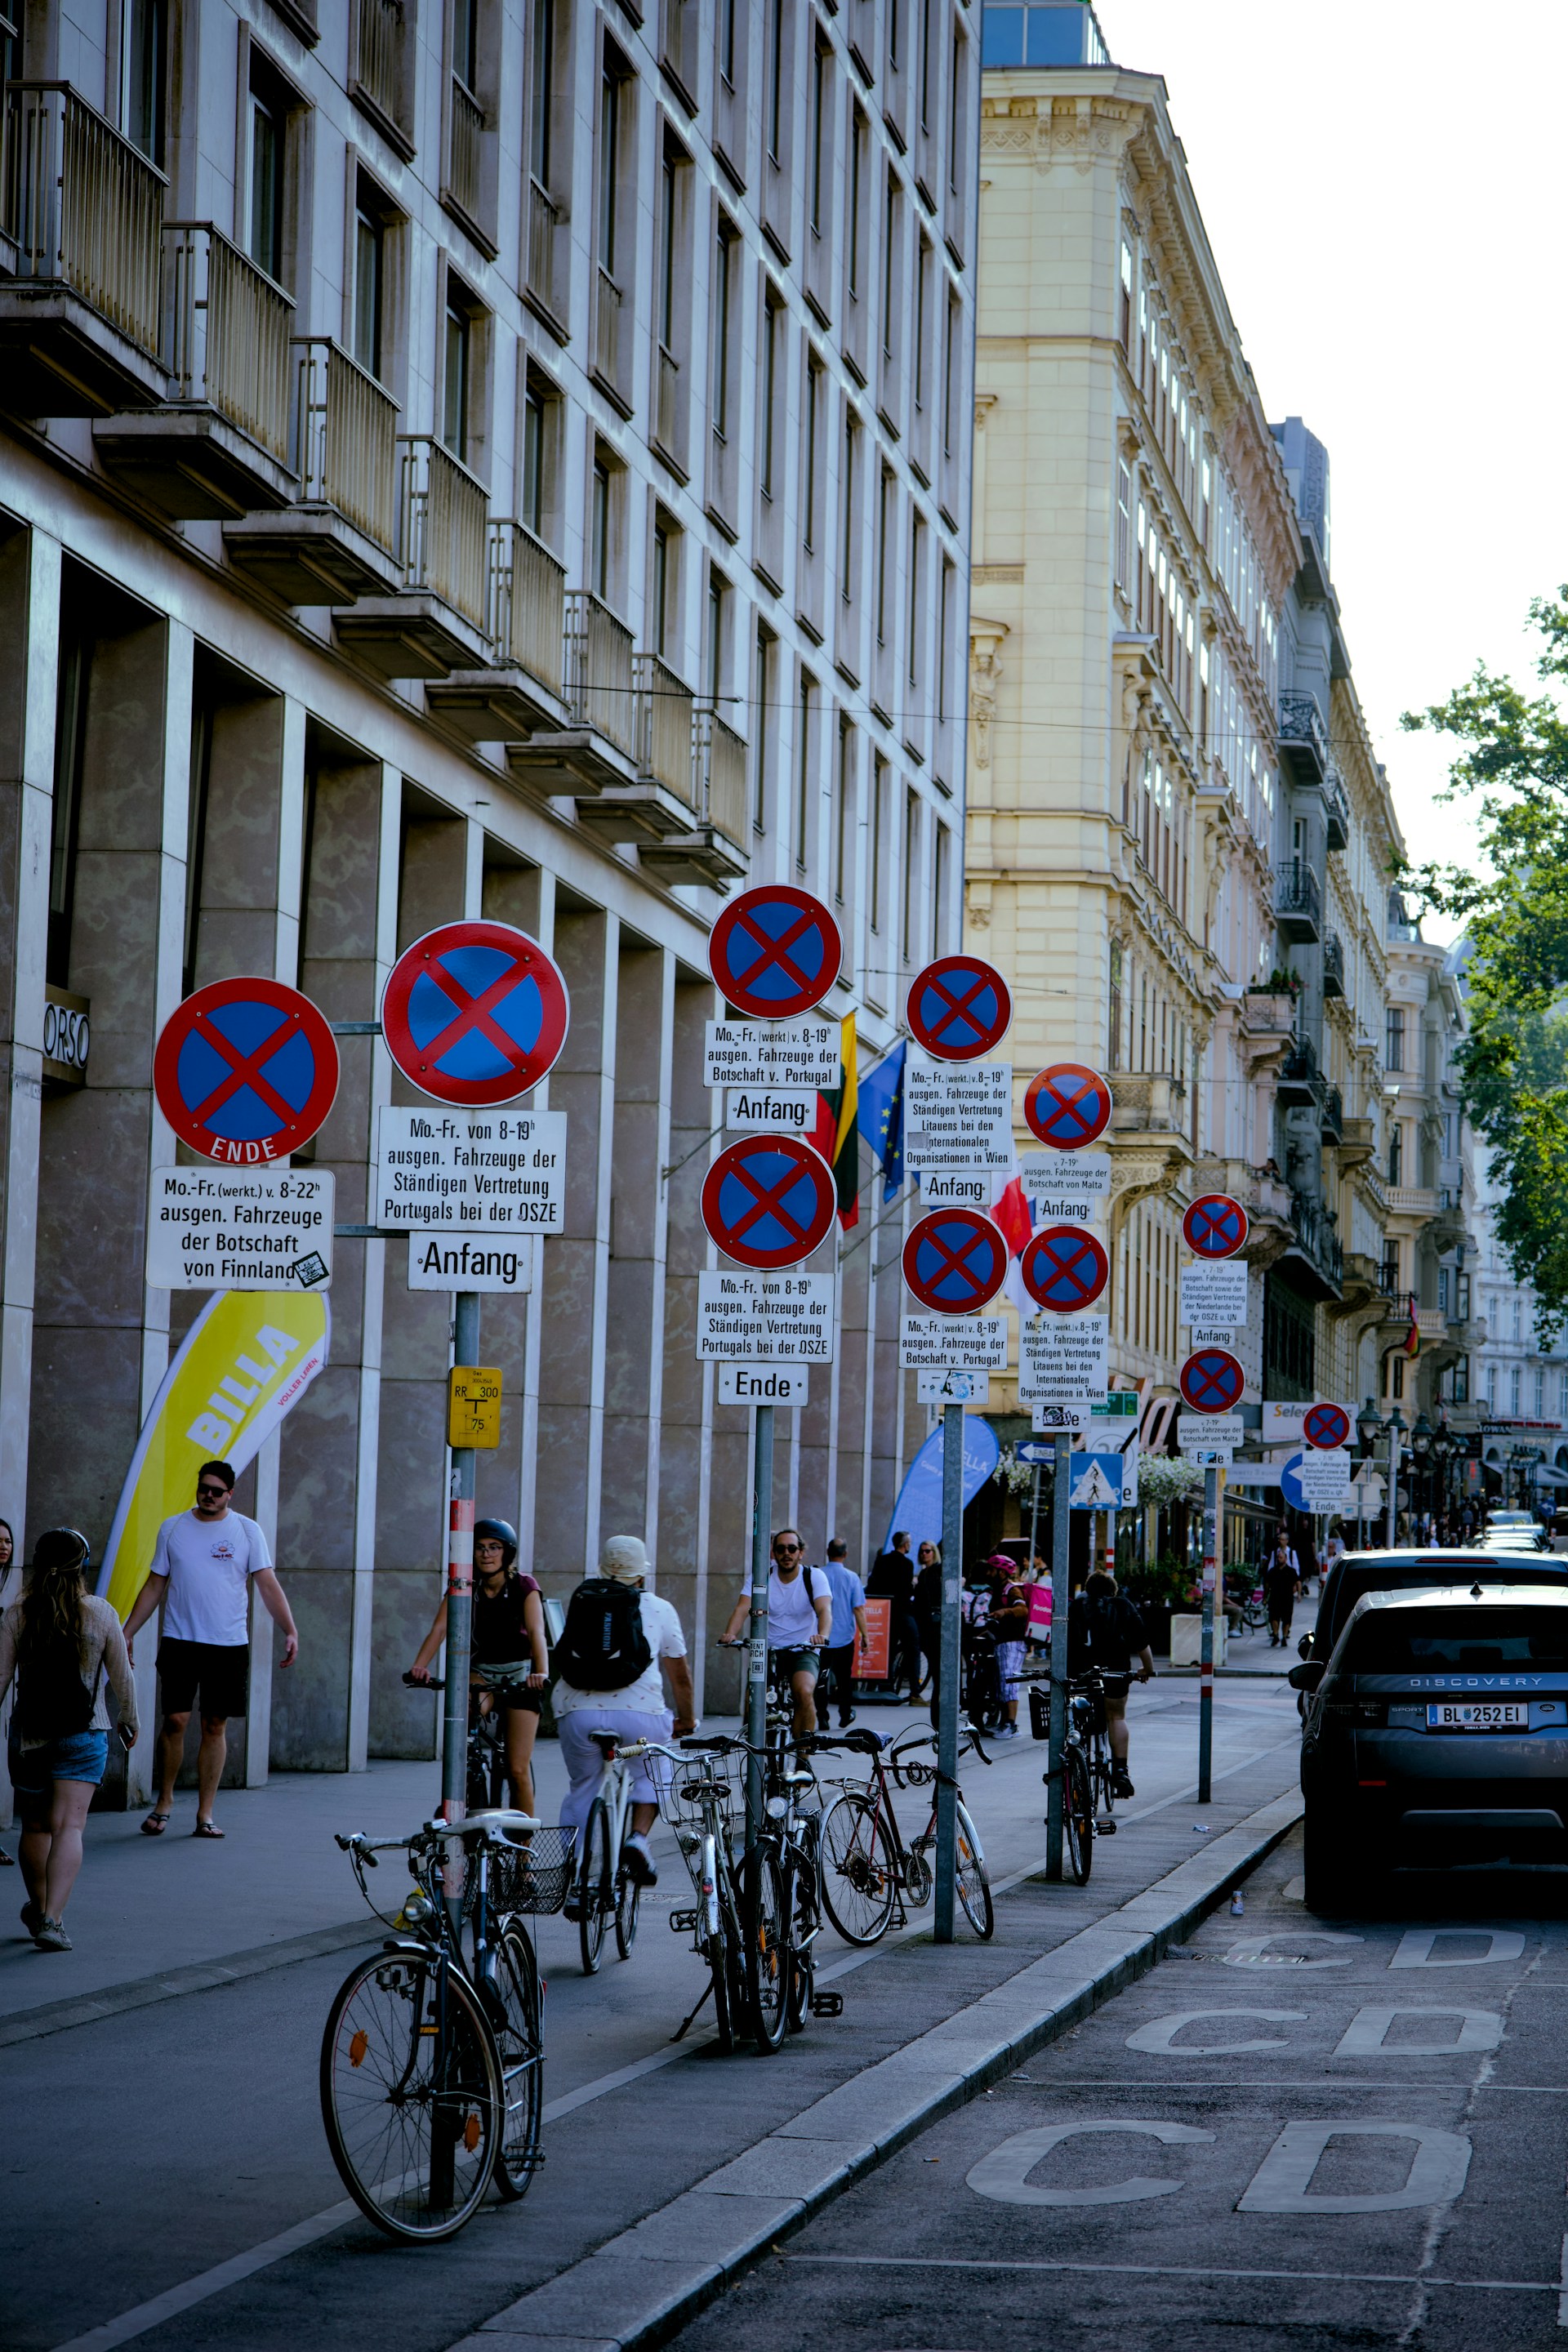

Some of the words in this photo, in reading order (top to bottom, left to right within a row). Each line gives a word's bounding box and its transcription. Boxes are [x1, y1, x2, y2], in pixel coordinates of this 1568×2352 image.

[715, 1027, 756, 1042] Mo.-Fr.
[791, 1034, 800, 1043] v.
[708, 1050, 752, 1064] ausgen.
[759, 1048, 813, 1066] Fahrzeuge
[819, 1049, 837, 1063] der
[713, 1067, 765, 1082] Botschaft
[769, 1071, 779, 1082] v.
[786, 1068, 831, 1086] Portugal
[909, 1090, 942, 1102] ausgen.
[947, 1088, 989, 1102] Fahrzeuge
[993, 1089, 1007, 1099] der
[737, 1095, 805, 1126] Anfang
[913, 1104, 956, 1117] Ständigen
[959, 1104, 1003, 1118] Vertretung
[410, 1119, 460, 1138] Mo.-Fr.
[468, 1125, 491, 1139] von
[922, 1120, 957, 1131] Litauens
[961, 1120, 974, 1131] bei
[978, 1120, 993, 1131] den
[929, 1136, 989, 1147] nternationalen
[211, 1137, 278, 1162] ENDE
[388, 1150, 445, 1169] ausgen.
[454, 1147, 525, 1171] Fahrzeuge
[532, 1149, 556, 1168] der
[907, 1152, 970, 1165] Organisationen
[974, 1152, 982, 1163] in
[986, 1152, 1009, 1163] Wien
[1024, 1169, 1053, 1177] ausgen.
[1055, 1168, 1093, 1178] Fahrzeuge
[165, 1179, 216, 1196] Mo.-Fr.
[218, 1183, 262, 1199] (werkt.)
[266, 1188, 274, 1198] v.
[394, 1173, 467, 1196] Ständigen
[474, 1174, 549, 1200] Vertretung
[929, 1178, 982, 1200] Anfang
[1029, 1179, 1063, 1188] Botschaft
[1082, 1181, 1102, 1189] Malta
[161, 1207, 227, 1226] ausgen.
[234, 1205, 323, 1228] Fahrzeuge
[385, 1199, 452, 1223] Portugals
[461, 1201, 482, 1221] bei
[490, 1202, 513, 1221] der
[519, 1202, 557, 1223] OSZE
[1042, 1200, 1087, 1220] Anfang
[182, 1232, 210, 1250] der
[216, 1233, 299, 1253] Botschaft
[185, 1263, 214, 1276] von
[221, 1259, 295, 1279] Finnland
[423, 1241, 517, 1284] Anfang
[720, 1279, 757, 1294] Mo.-Fr.
[762, 1284, 780, 1294] von
[1206, 1275, 1236, 1283] Fahrzeuge
[1183, 1294, 1212, 1302] Ständigen
[1214, 1294, 1245, 1303] Vertretung
[705, 1302, 746, 1316] ausgen.
[752, 1299, 804, 1318] Fahrzeuge
[809, 1301, 827, 1315] der
[709, 1318, 762, 1337] Ständigen
[767, 1320, 822, 1338] Vertretung
[908, 1321, 940, 1332] Mo.-Fr.
[902, 1339, 937, 1350] ausgen.
[990, 1338, 1004, 1349] der
[1022, 1336, 1050, 1346] ausgen.
[1054, 1334, 1089, 1347] Fahrzeuge
[1092, 1335, 1103, 1345] der
[1196, 1330, 1230, 1344] Anfang
[702, 1338, 751, 1356] Portugals
[757, 1339, 773, 1354] bei
[778, 1340, 795, 1354] der
[800, 1340, 827, 1355] OSZE
[1026, 1348, 1061, 1359] Ständigen
[1063, 1348, 1101, 1361] Vertretung
[906, 1352, 947, 1364] Botschaft
[964, 1353, 1000, 1367] Portugal
[1033, 1361, 1062, 1371] Litauens
[1066, 1361, 1076, 1371] bei
[1080, 1361, 1093, 1371] den
[736, 1371, 791, 1397] Ende
[1036, 1374, 1089, 1384] Internationalen
[185, 1324, 301, 1455] BILLA
[278, 1379, 302, 1406] VOLLER
[456, 1387, 466, 1396] RR
[480, 1388, 498, 1397] 300
[1021, 1387, 1073, 1399] Organisationen
[1076, 1388, 1083, 1397] in
[1086, 1388, 1105, 1398] Wien
[473, 1419, 483, 1429] 75
[1410, 1677, 1543, 1686] DISCOVERY
[1444, 1708, 1461, 1722] BL
